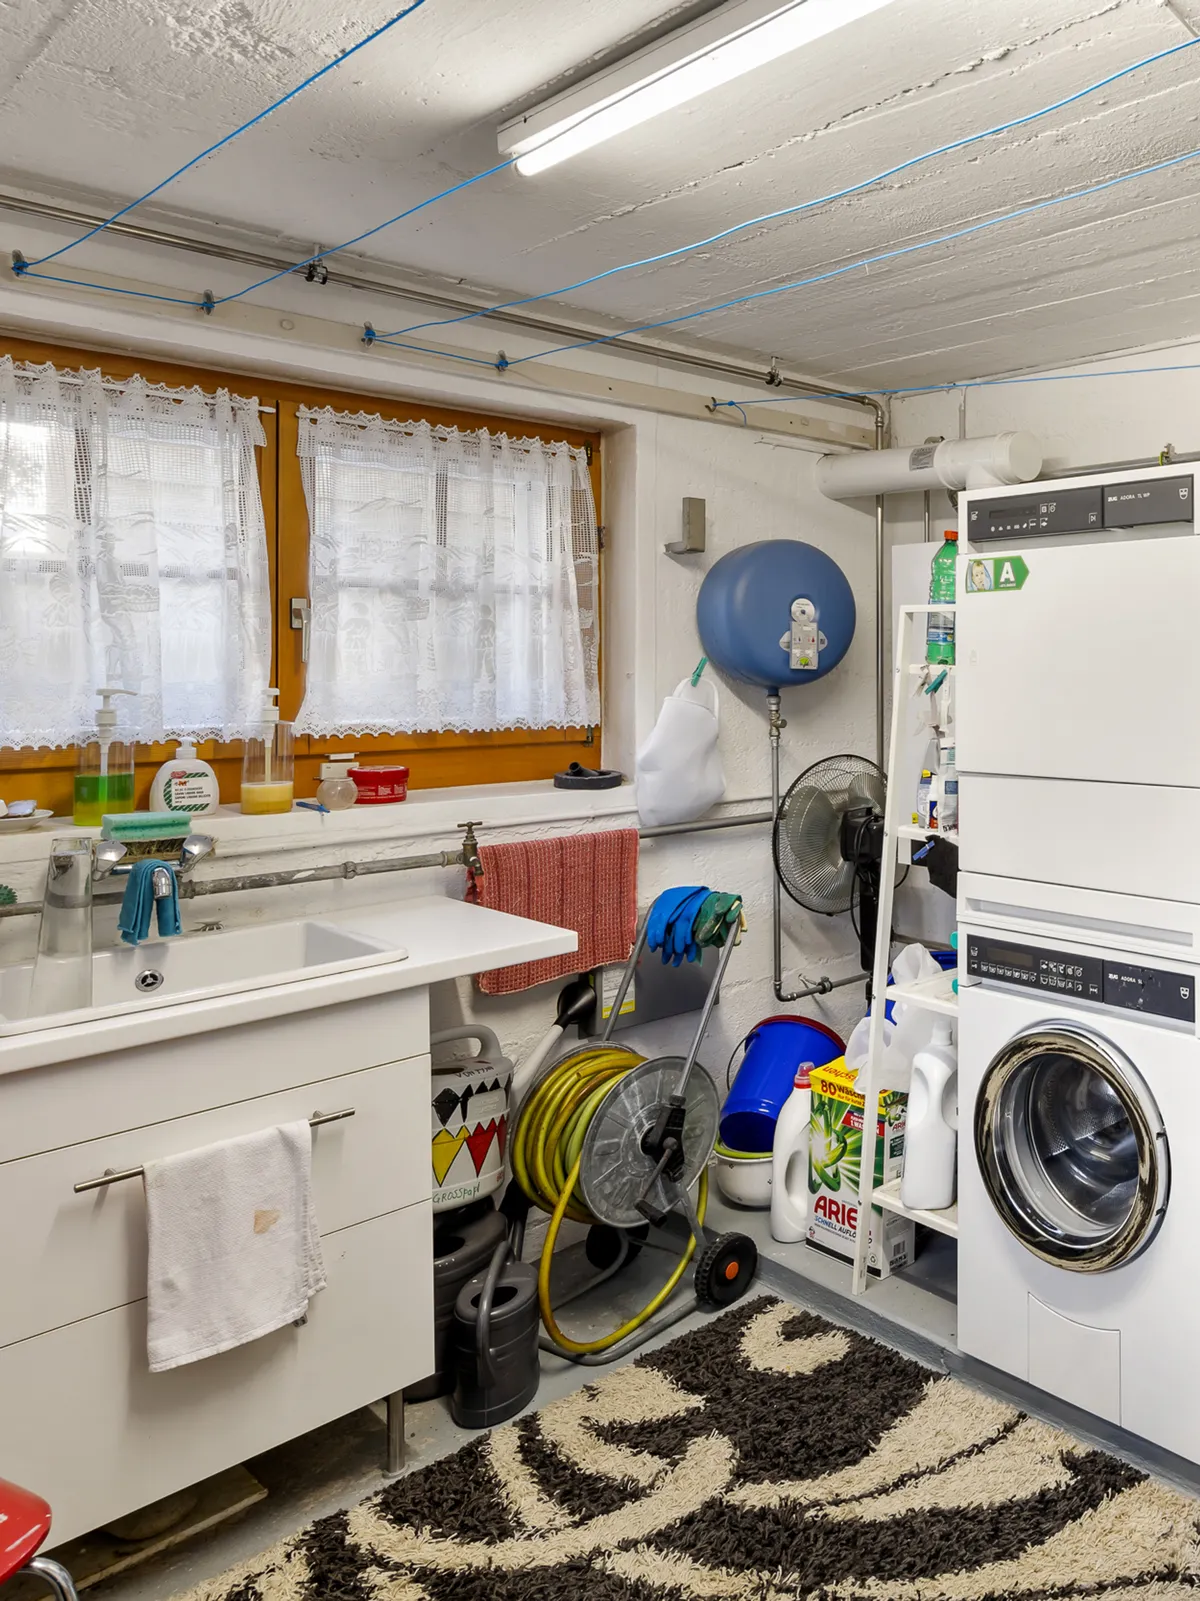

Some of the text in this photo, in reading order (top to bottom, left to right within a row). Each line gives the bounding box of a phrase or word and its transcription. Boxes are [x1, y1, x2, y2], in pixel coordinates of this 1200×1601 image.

[999, 560, 1016, 583] A
[821, 1079, 837, 1096] 80
[814, 1195, 858, 1230] ARIE
[815, 1215, 838, 1230] SCHNELL
